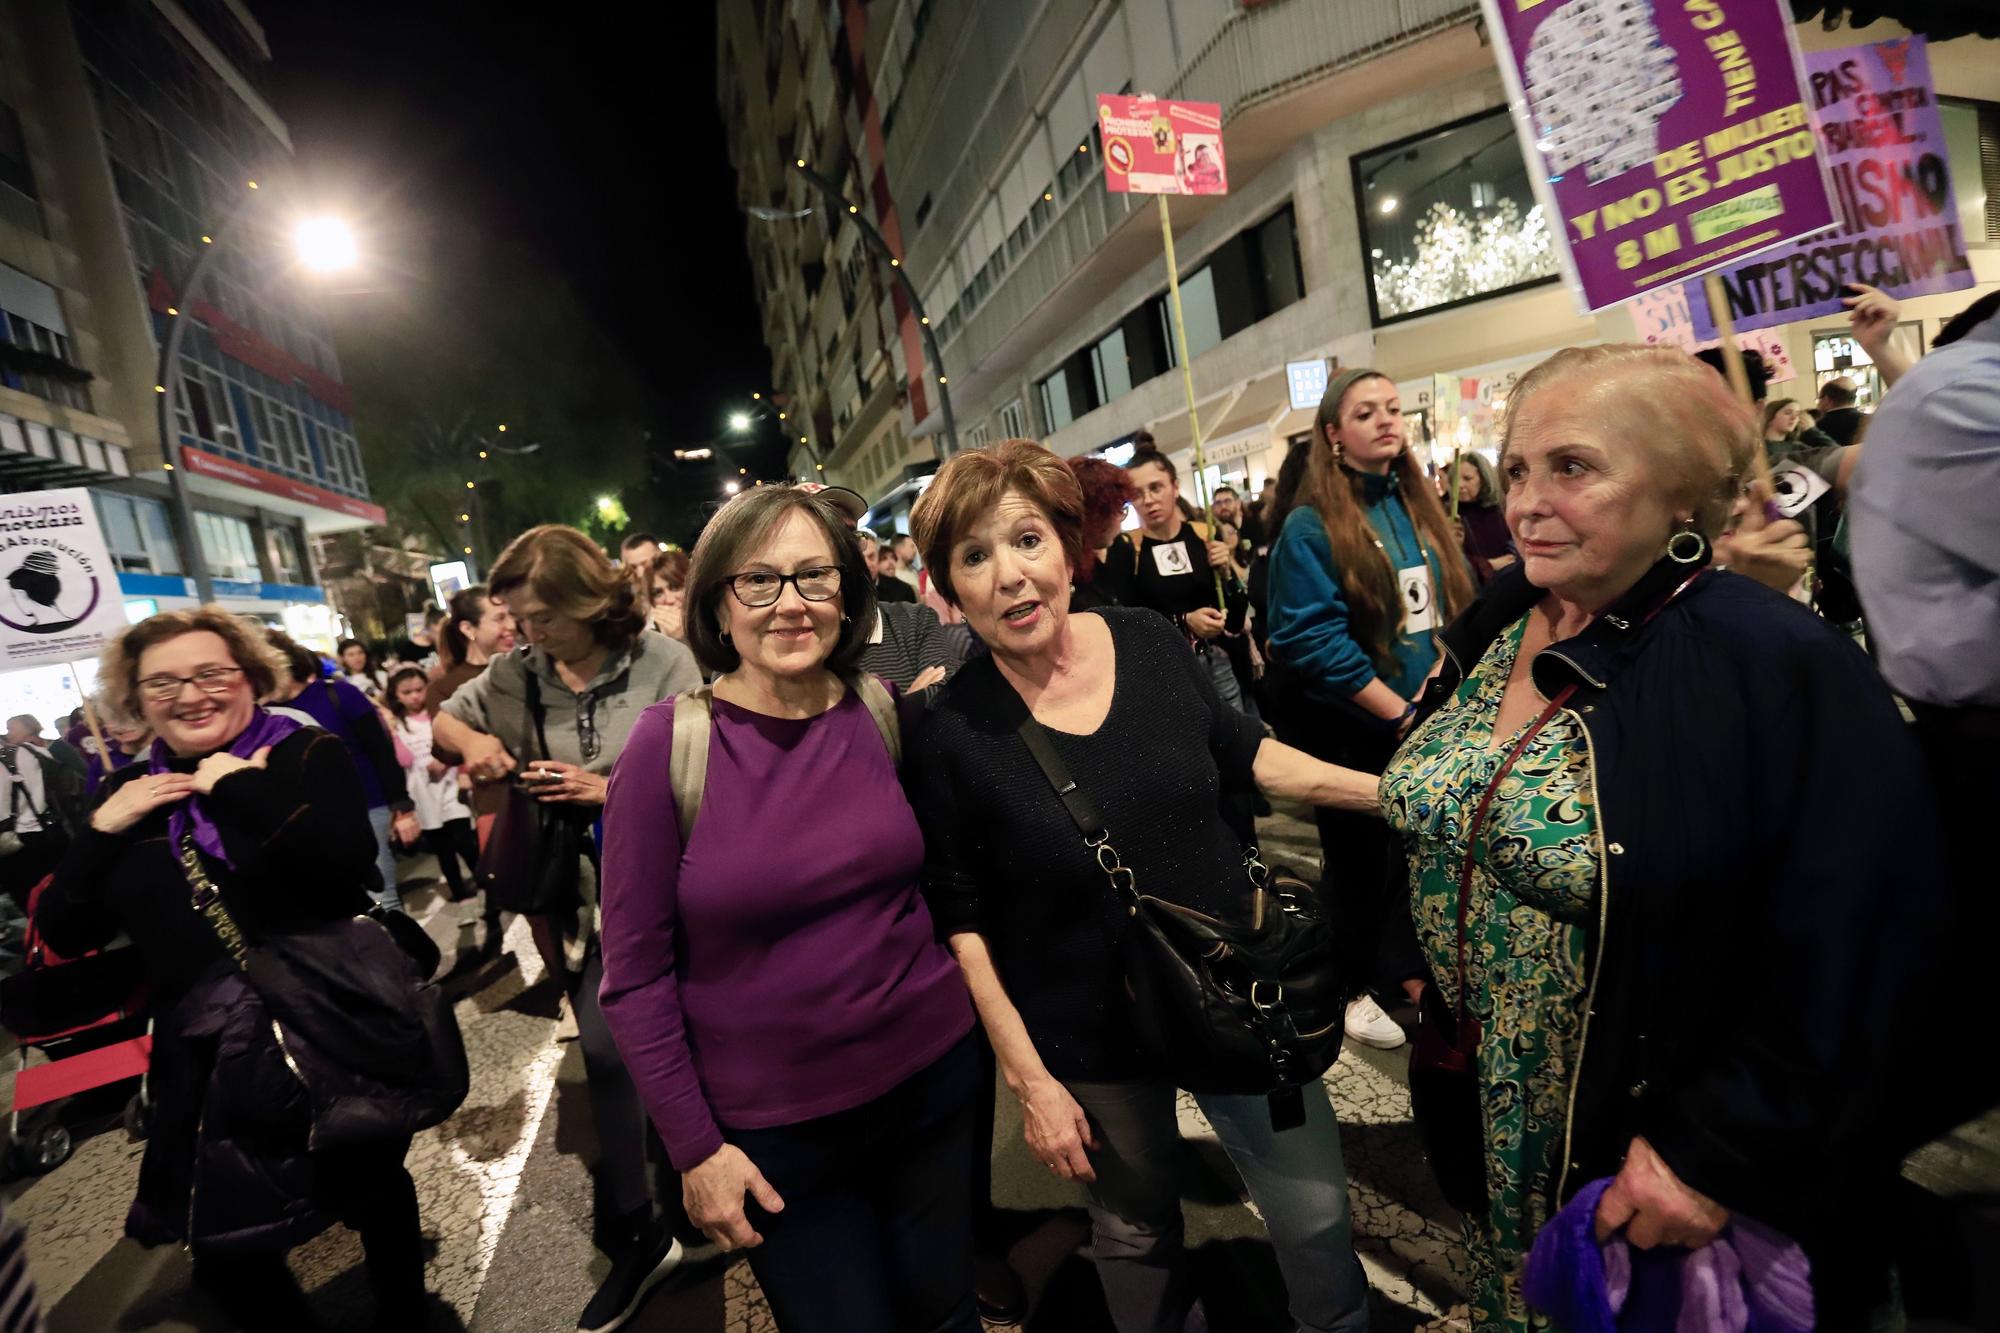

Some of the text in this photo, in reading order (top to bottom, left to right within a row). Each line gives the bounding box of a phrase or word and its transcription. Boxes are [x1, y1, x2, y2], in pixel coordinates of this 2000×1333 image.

[1703, 29, 1757, 118] TIENE
[1653, 102, 1809, 179] DE MUJER
[1569, 210, 1598, 241] Y
[1601, 187, 1662, 232] NO
[1663, 167, 1711, 207] ES
[1713, 130, 1815, 189] JUSTO
[1614, 239, 1643, 271] 8
[1643, 223, 1682, 261] M
